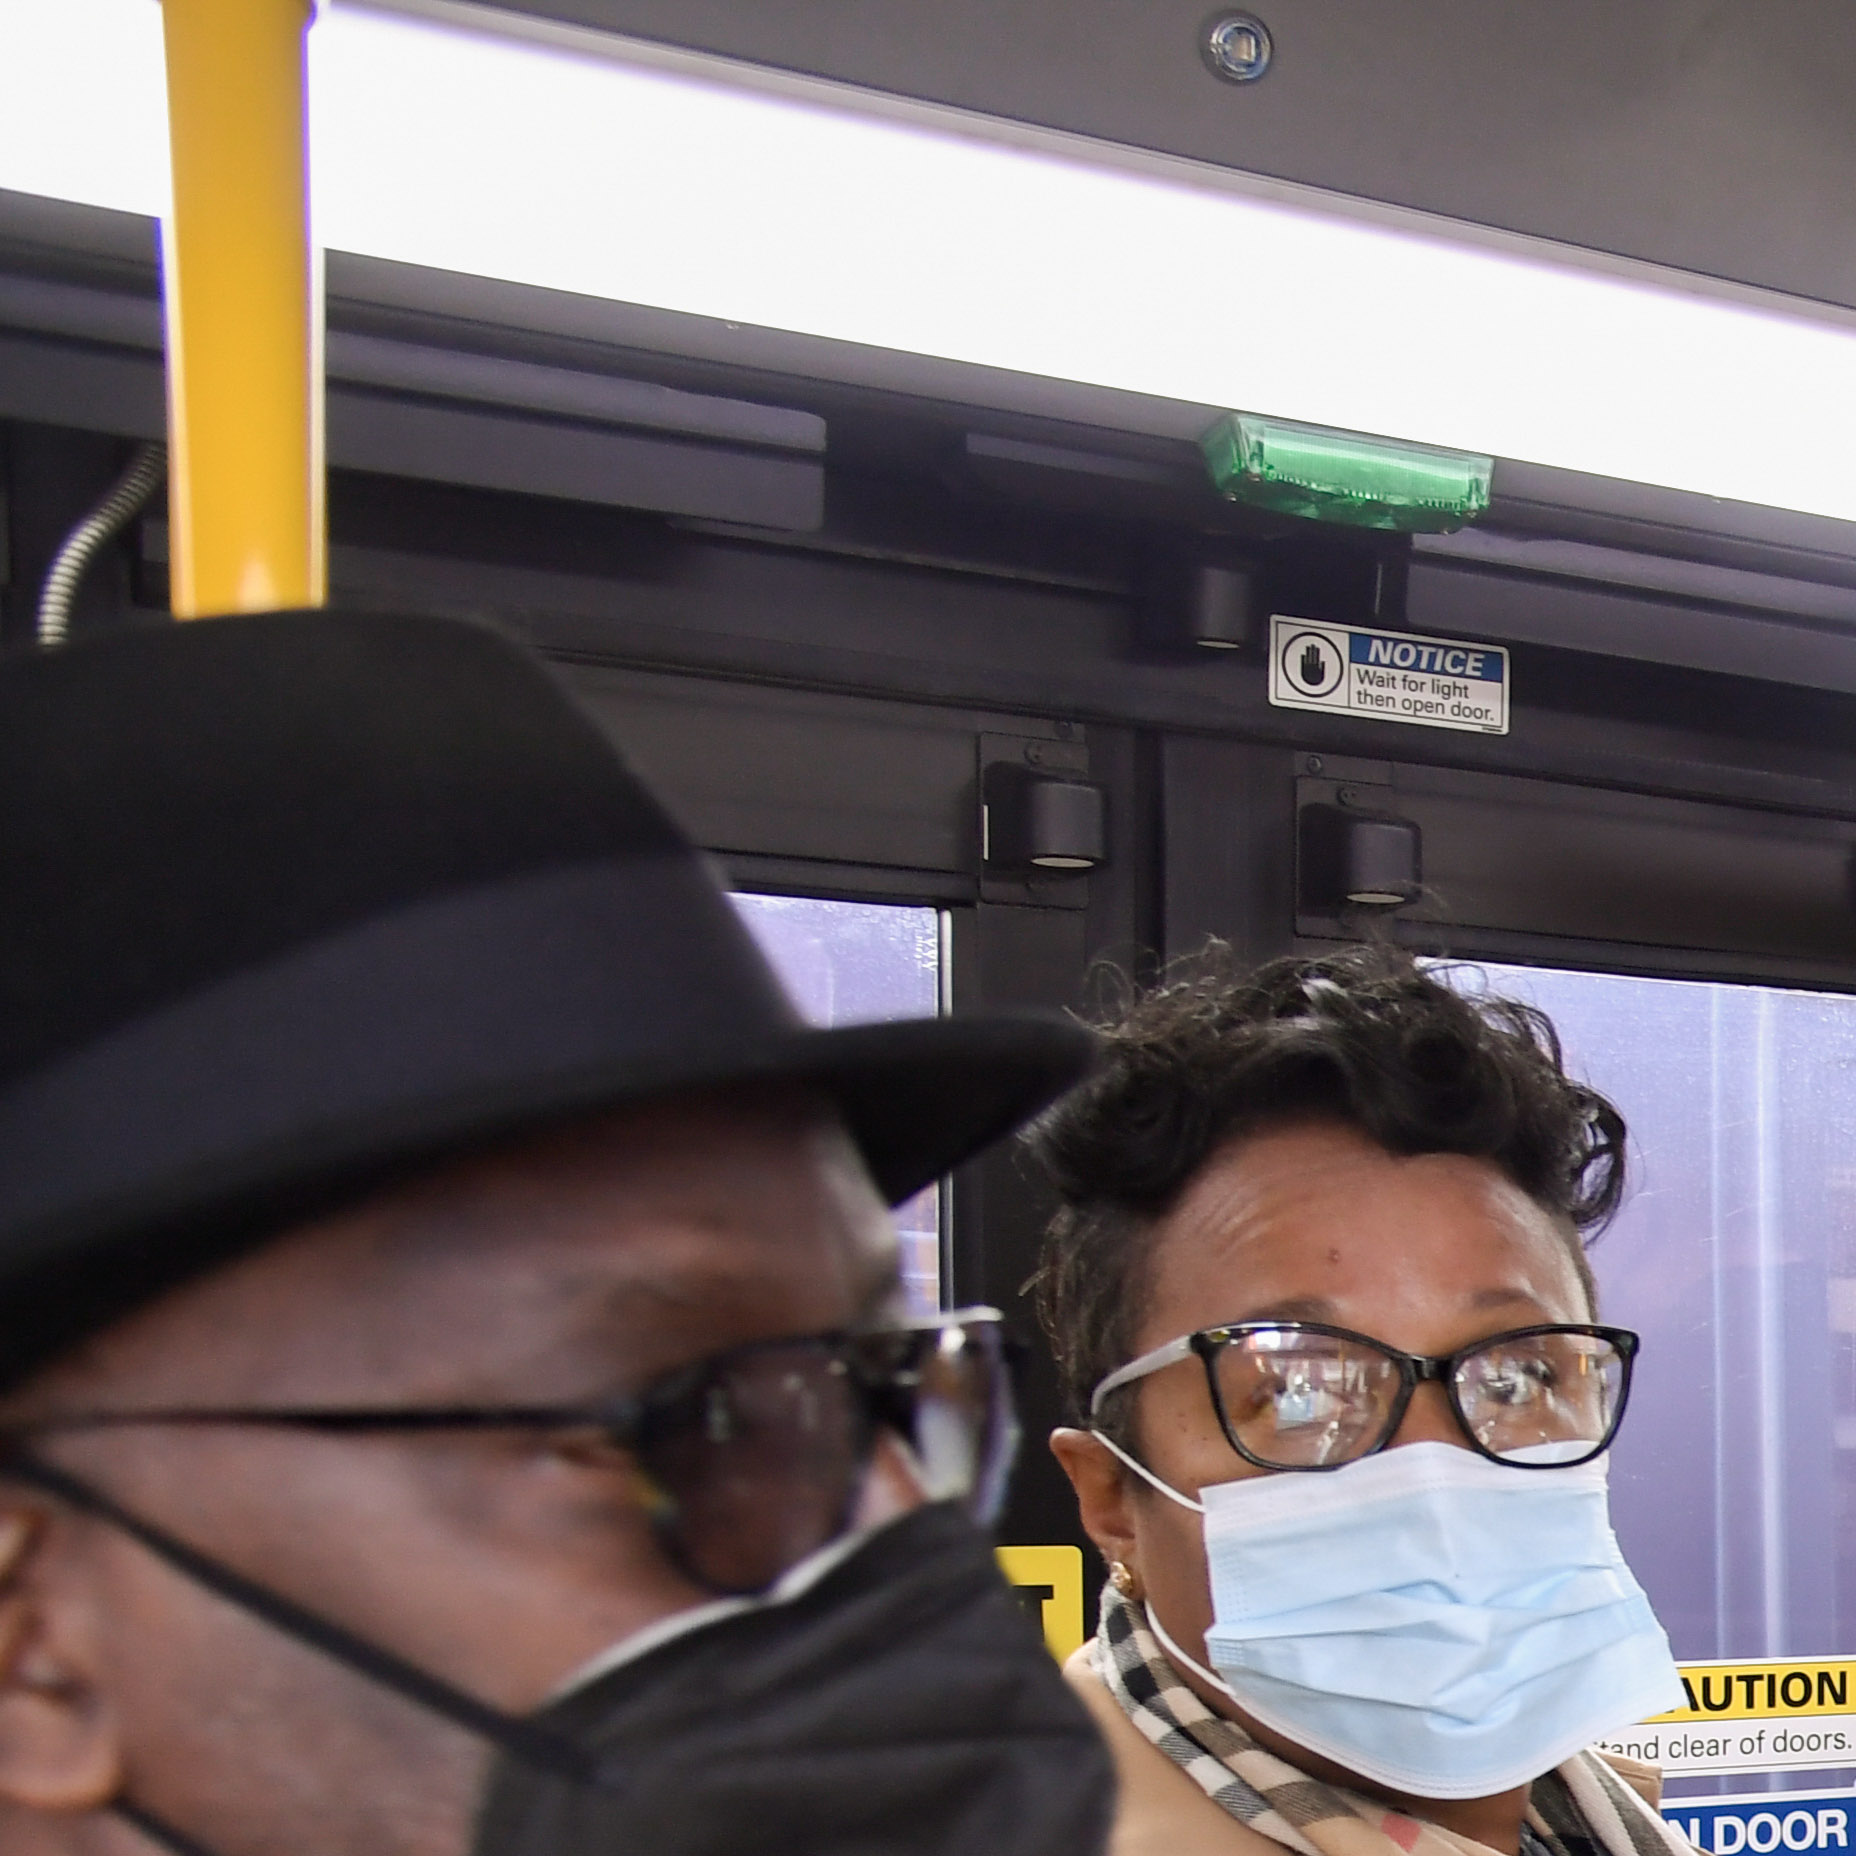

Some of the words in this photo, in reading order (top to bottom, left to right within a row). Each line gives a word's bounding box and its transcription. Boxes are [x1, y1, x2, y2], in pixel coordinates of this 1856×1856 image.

[1368, 639, 1485, 677] NOTICE
[1355, 668, 1397, 690] Wait
[1401, 674, 1426, 693] for
[1430, 678, 1470, 700] light
[1356, 688, 1396, 708] then
[1401, 698, 1445, 717] open
[1450, 700, 1496, 722] door.
[1664, 1671, 1848, 1713] AUTION
[1593, 1735, 1660, 1760] tand
[1668, 1733, 1732, 1759] clear
[1739, 1730, 1767, 1754] of
[1772, 1728, 1854, 1754] doors.
[1713, 1808, 1849, 1856] DOOR
